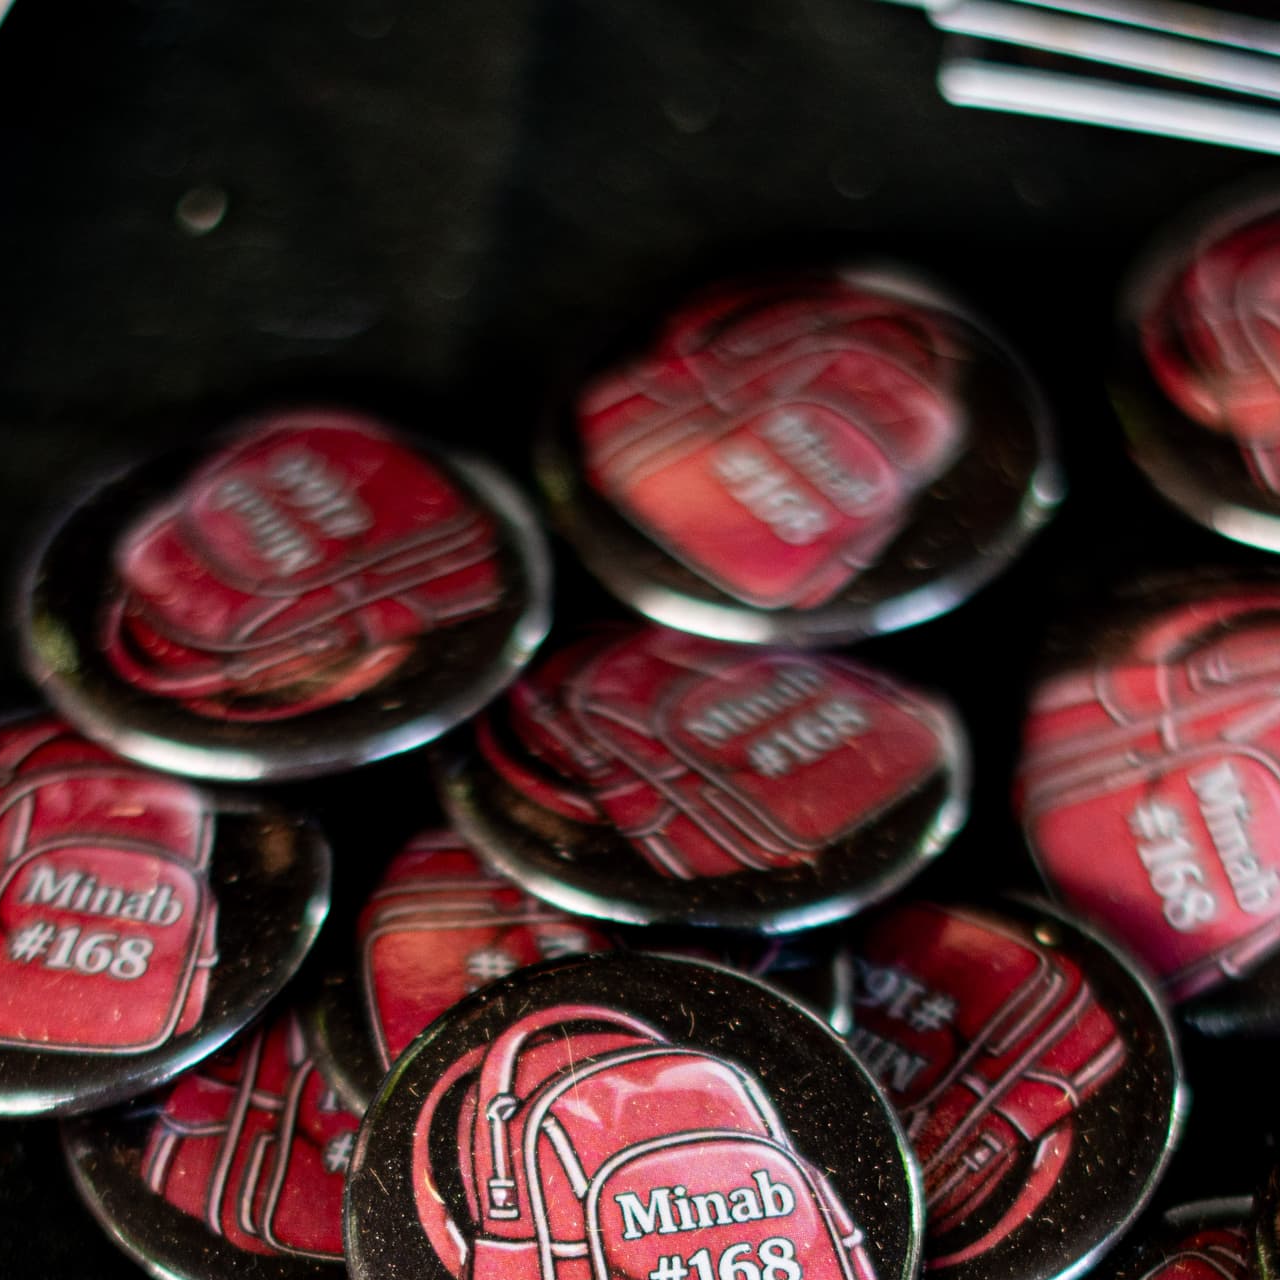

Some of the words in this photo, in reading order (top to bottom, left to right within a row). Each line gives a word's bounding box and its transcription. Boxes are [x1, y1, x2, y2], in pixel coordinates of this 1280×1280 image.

[21, 865, 183, 927] Minab
[1126, 800, 1218, 935] #168
[9, 920, 155, 981] #168
[614, 1168, 797, 1241] Minab
